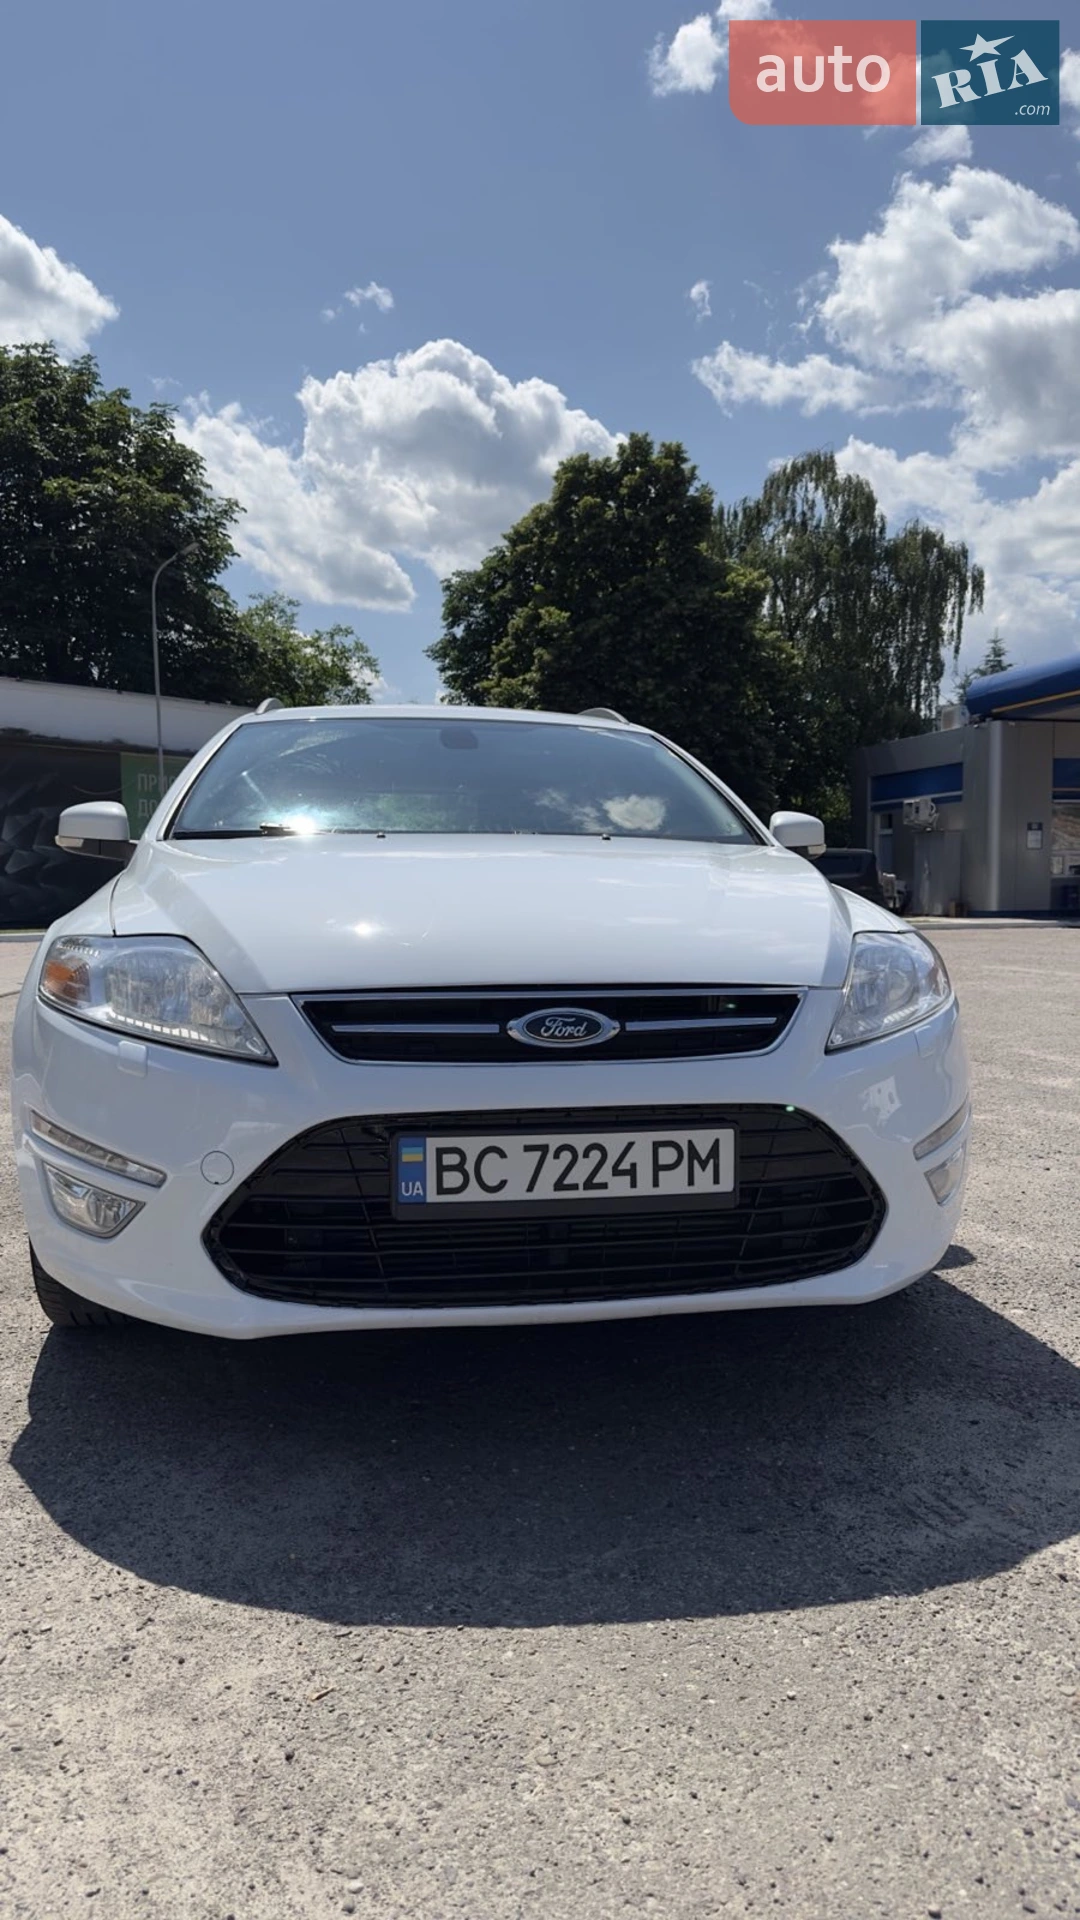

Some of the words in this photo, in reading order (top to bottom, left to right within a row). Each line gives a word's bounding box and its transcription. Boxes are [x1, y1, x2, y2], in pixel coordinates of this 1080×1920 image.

[540, 1016, 588, 1037] Ford
[435, 1145, 508, 1195] BC
[523, 1141, 637, 1193] 7224
[652, 1138, 720, 1188] PM
[401, 1181, 424, 1197] UA
